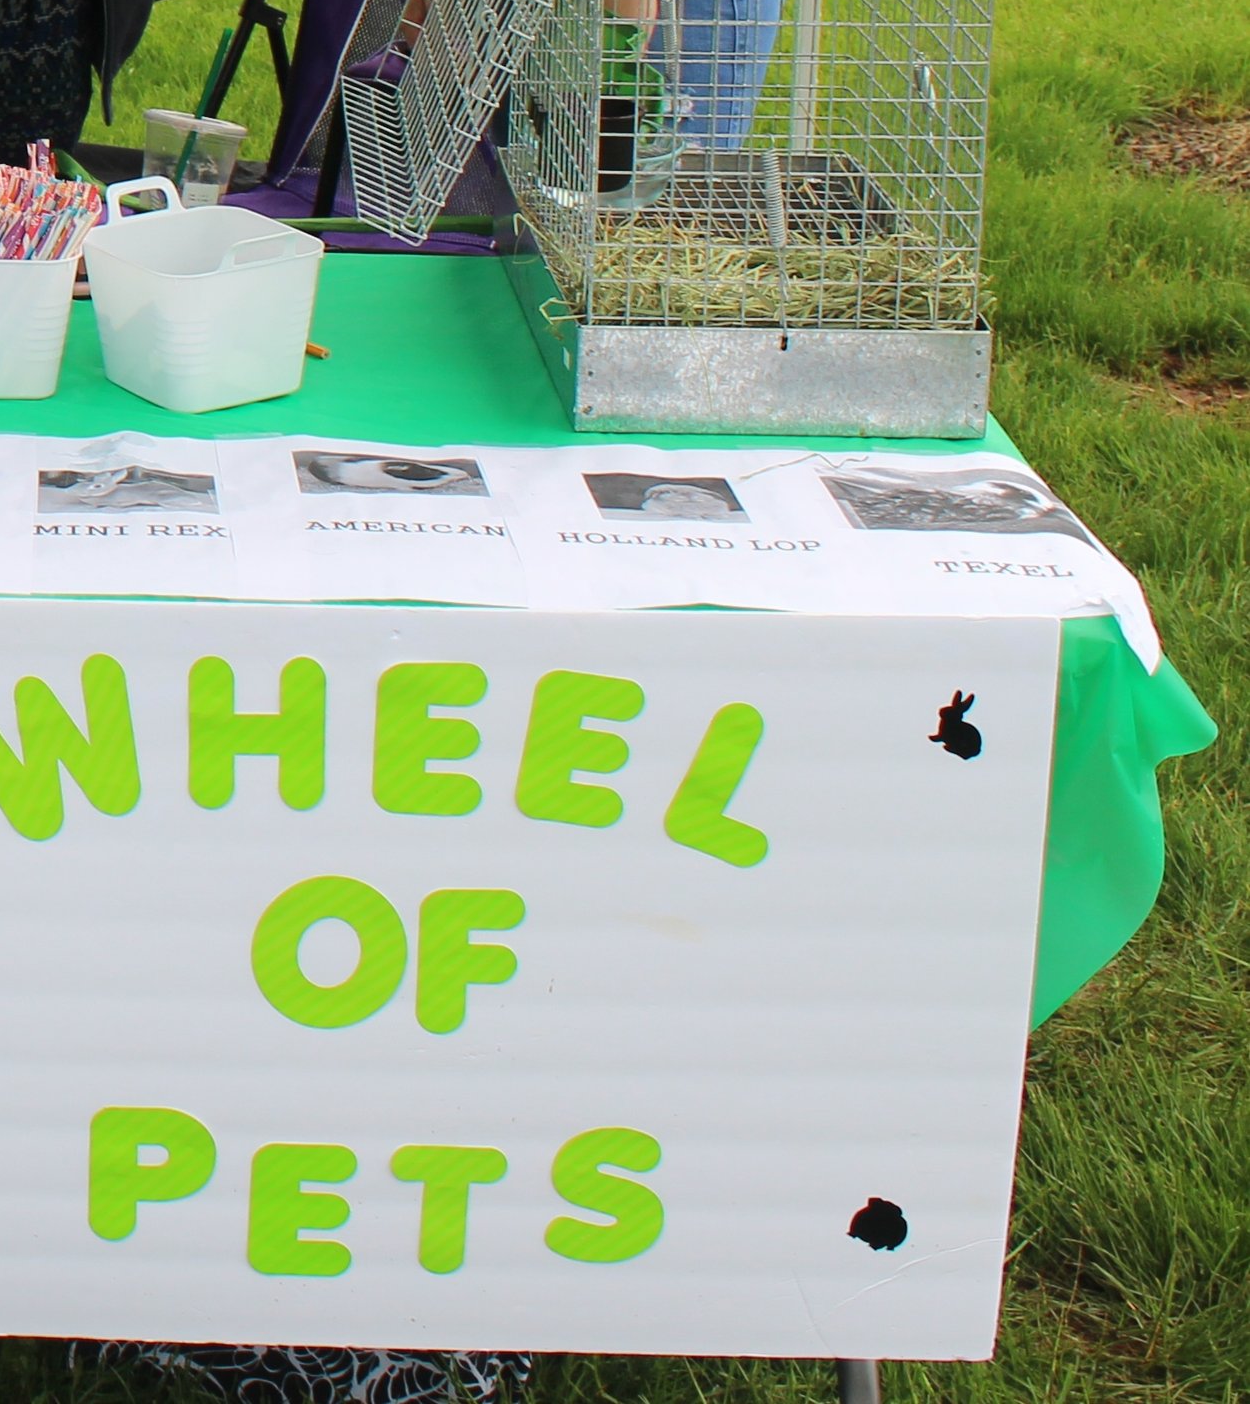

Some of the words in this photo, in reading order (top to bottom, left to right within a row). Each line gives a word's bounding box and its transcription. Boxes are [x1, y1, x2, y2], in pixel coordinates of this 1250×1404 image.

[33, 524, 129, 536] MINI
[147, 524, 228, 538] REX
[305, 520, 505, 537] AMERICAN
[557, 532, 735, 550] HOLLAND
[747, 539, 821, 552] LOP
[934, 560, 1074, 578] TEXEL
[251, 874, 526, 1034] OF
[87, 1106, 665, 1277] PETS
